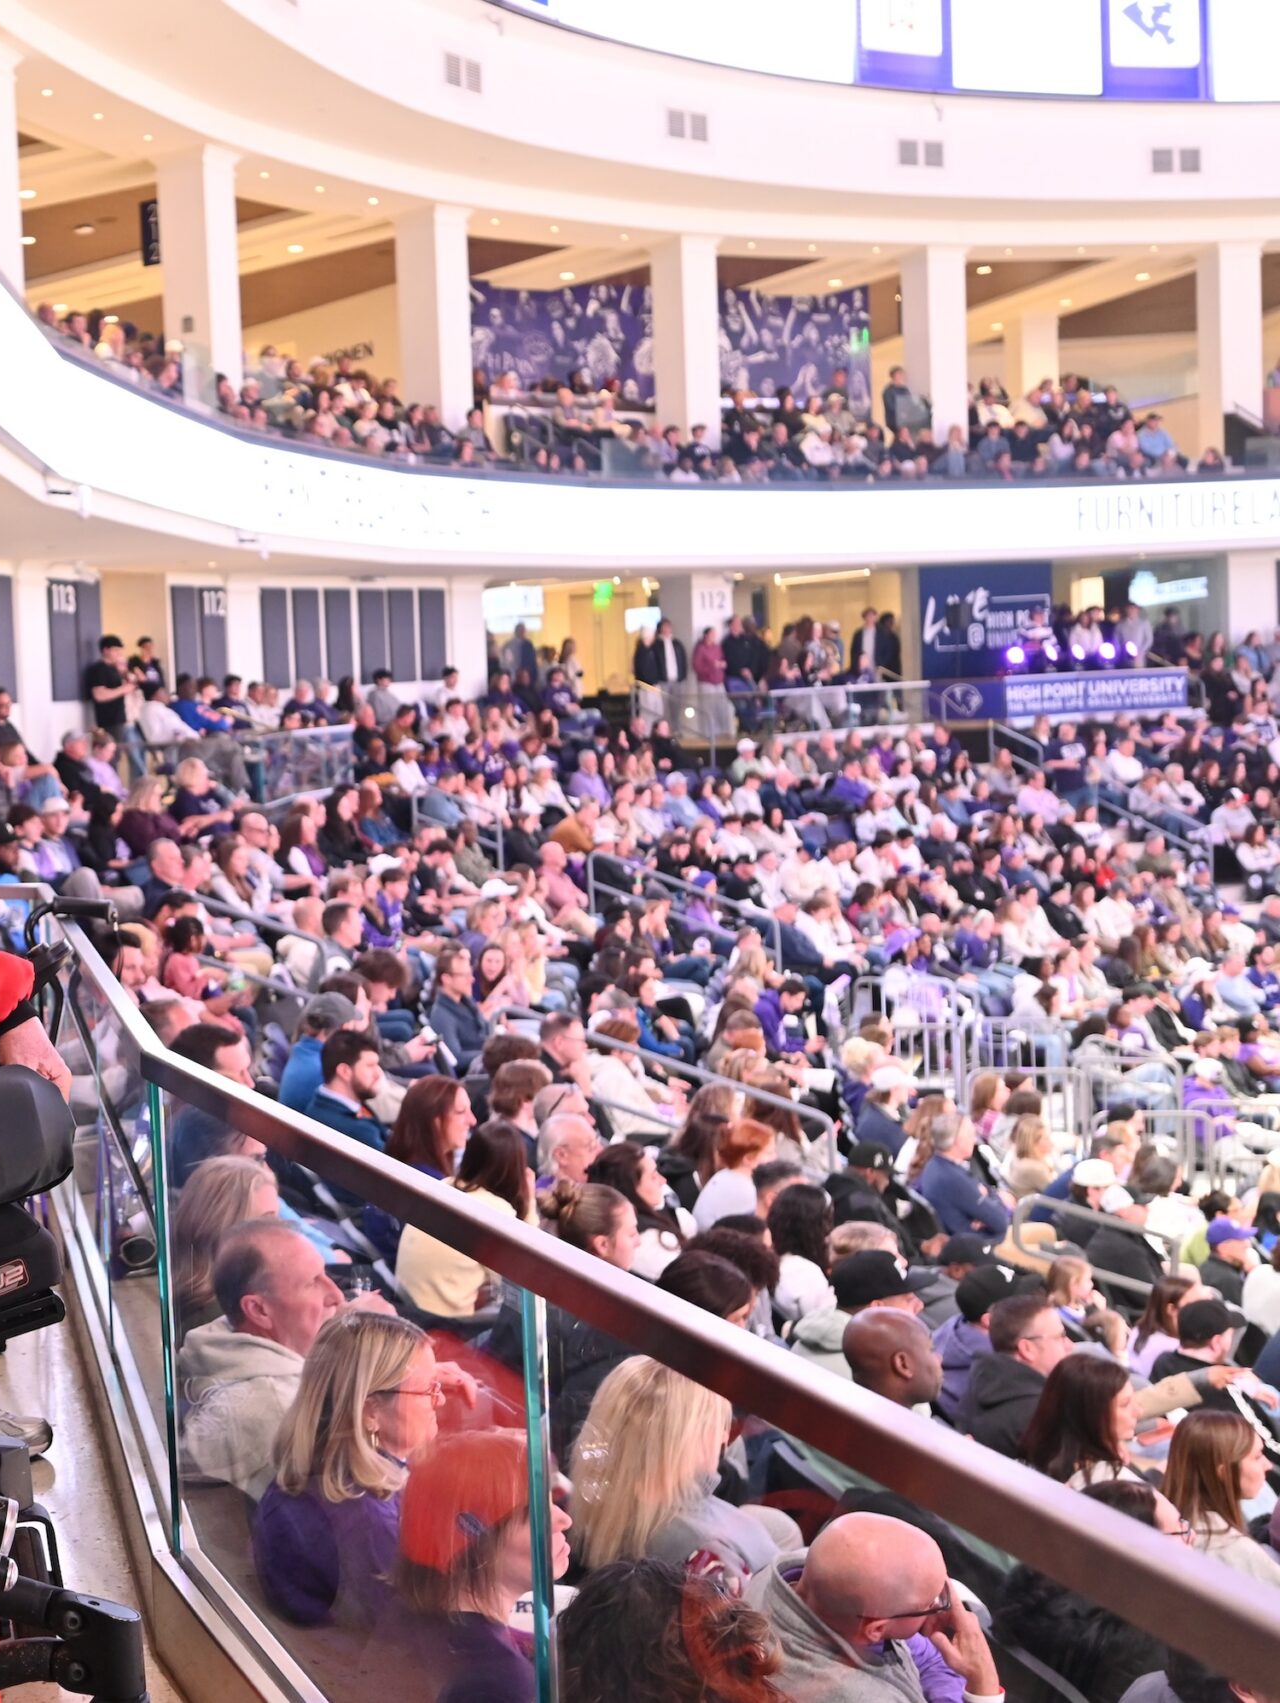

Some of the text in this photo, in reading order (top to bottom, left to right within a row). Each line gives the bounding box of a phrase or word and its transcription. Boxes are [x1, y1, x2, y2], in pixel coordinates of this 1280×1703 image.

[51, 584, 77, 614] 113
[700, 591, 726, 609] 112
[967, 622, 985, 651] @
[1006, 676, 1185, 700] HIGH POINT UNIVERSITY
